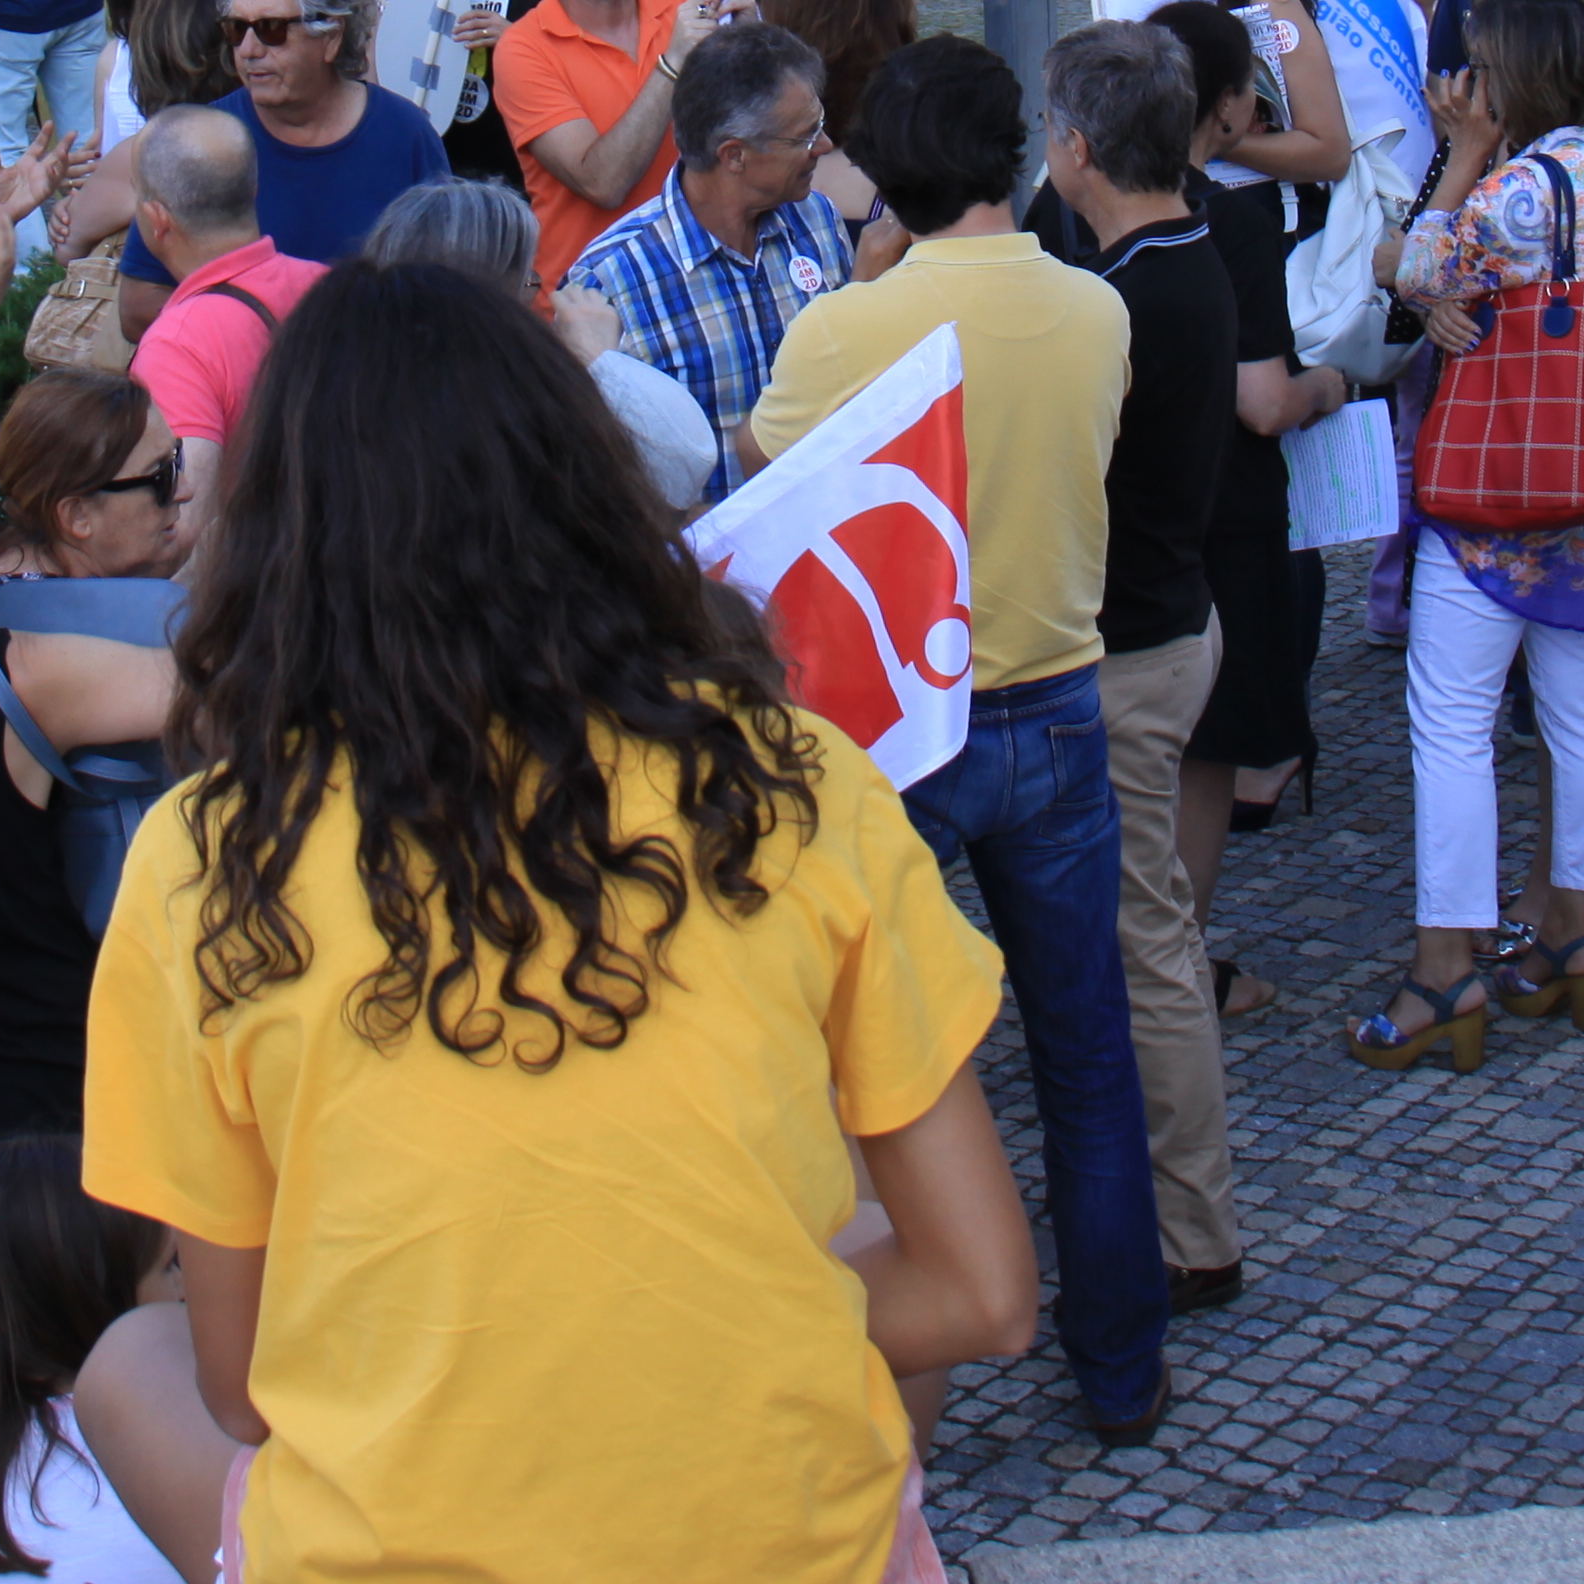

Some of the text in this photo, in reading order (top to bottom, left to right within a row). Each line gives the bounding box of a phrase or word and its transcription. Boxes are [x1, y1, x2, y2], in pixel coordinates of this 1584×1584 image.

[792, 257, 810, 269] 9A
[798, 267, 816, 278] 4M
[803, 277, 819, 290] 2D
